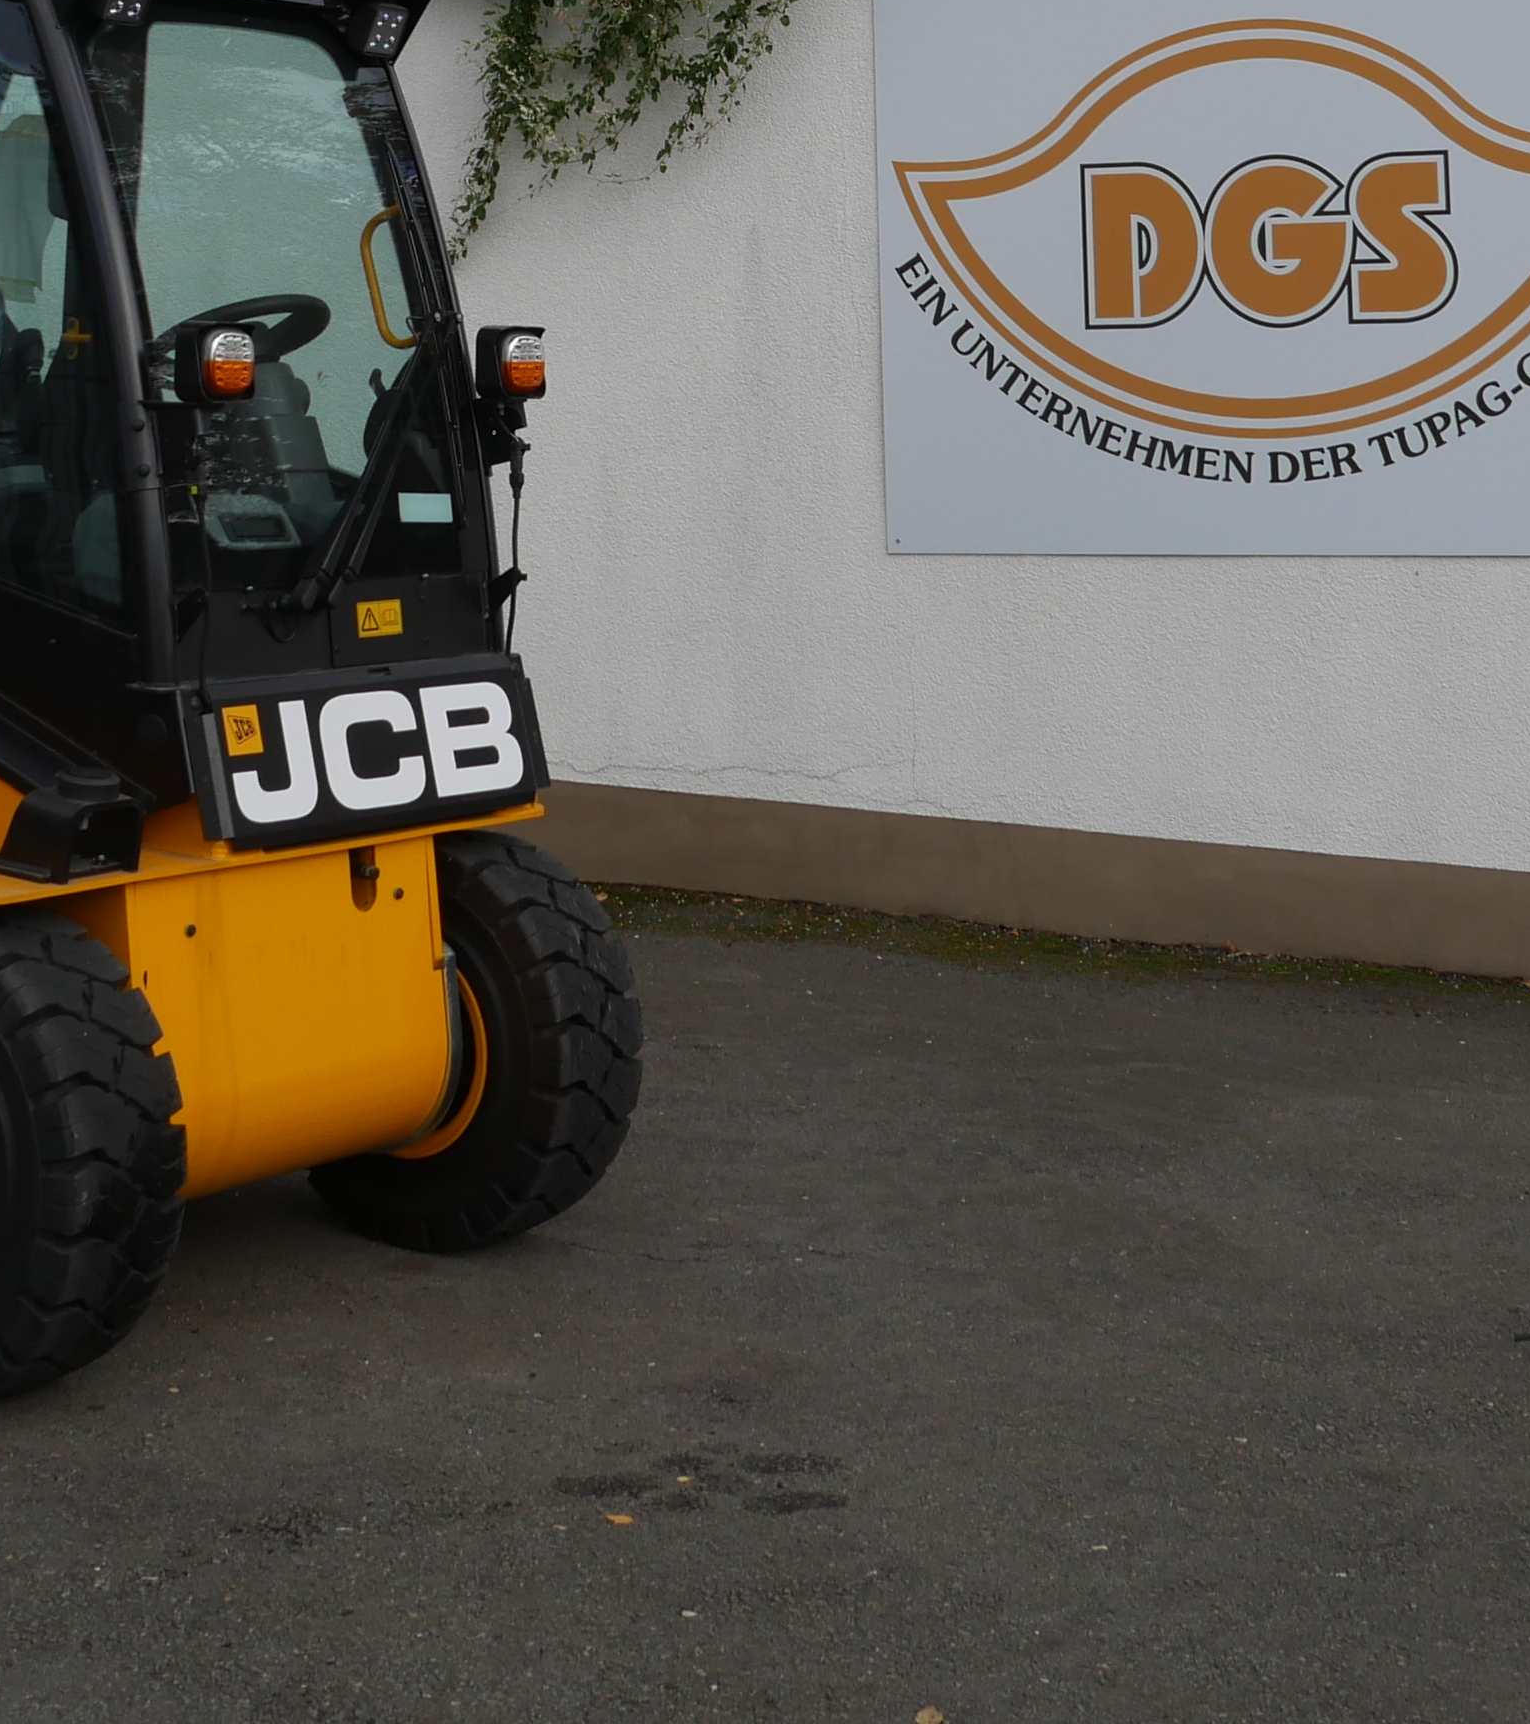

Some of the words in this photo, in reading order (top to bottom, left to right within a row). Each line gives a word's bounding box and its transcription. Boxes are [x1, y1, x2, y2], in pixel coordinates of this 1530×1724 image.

[1080, 149, 1459, 330] DGS
[895, 252, 959, 327] EIN
[950, 319, 1255, 484] UNTERNEHMEN
[1267, 441, 1363, 484] DER
[232, 681, 524, 824] JCB
